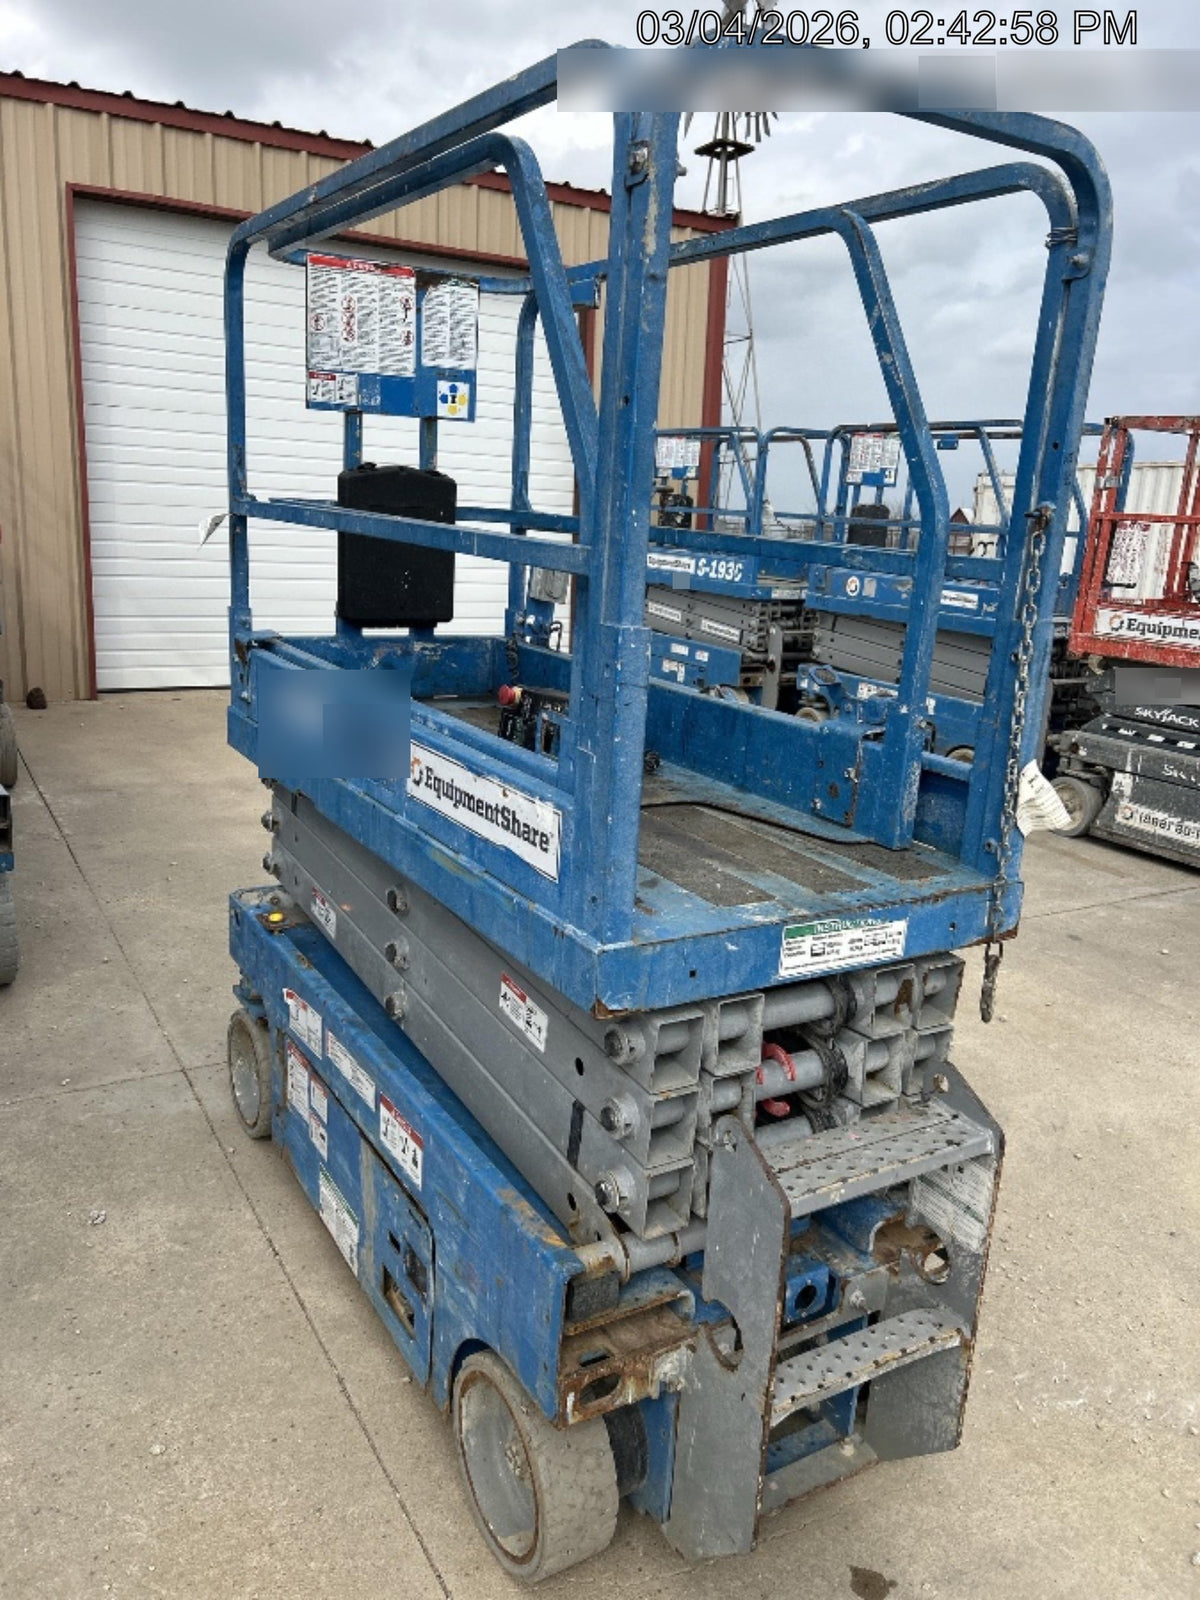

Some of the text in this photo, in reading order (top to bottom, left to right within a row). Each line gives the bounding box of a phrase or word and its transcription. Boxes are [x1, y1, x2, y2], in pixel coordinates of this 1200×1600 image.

[1126, 617, 1200, 640] Equipme
[1134, 706, 1199, 728] SKYJACK
[424, 765, 551, 854] EquipmentShare
